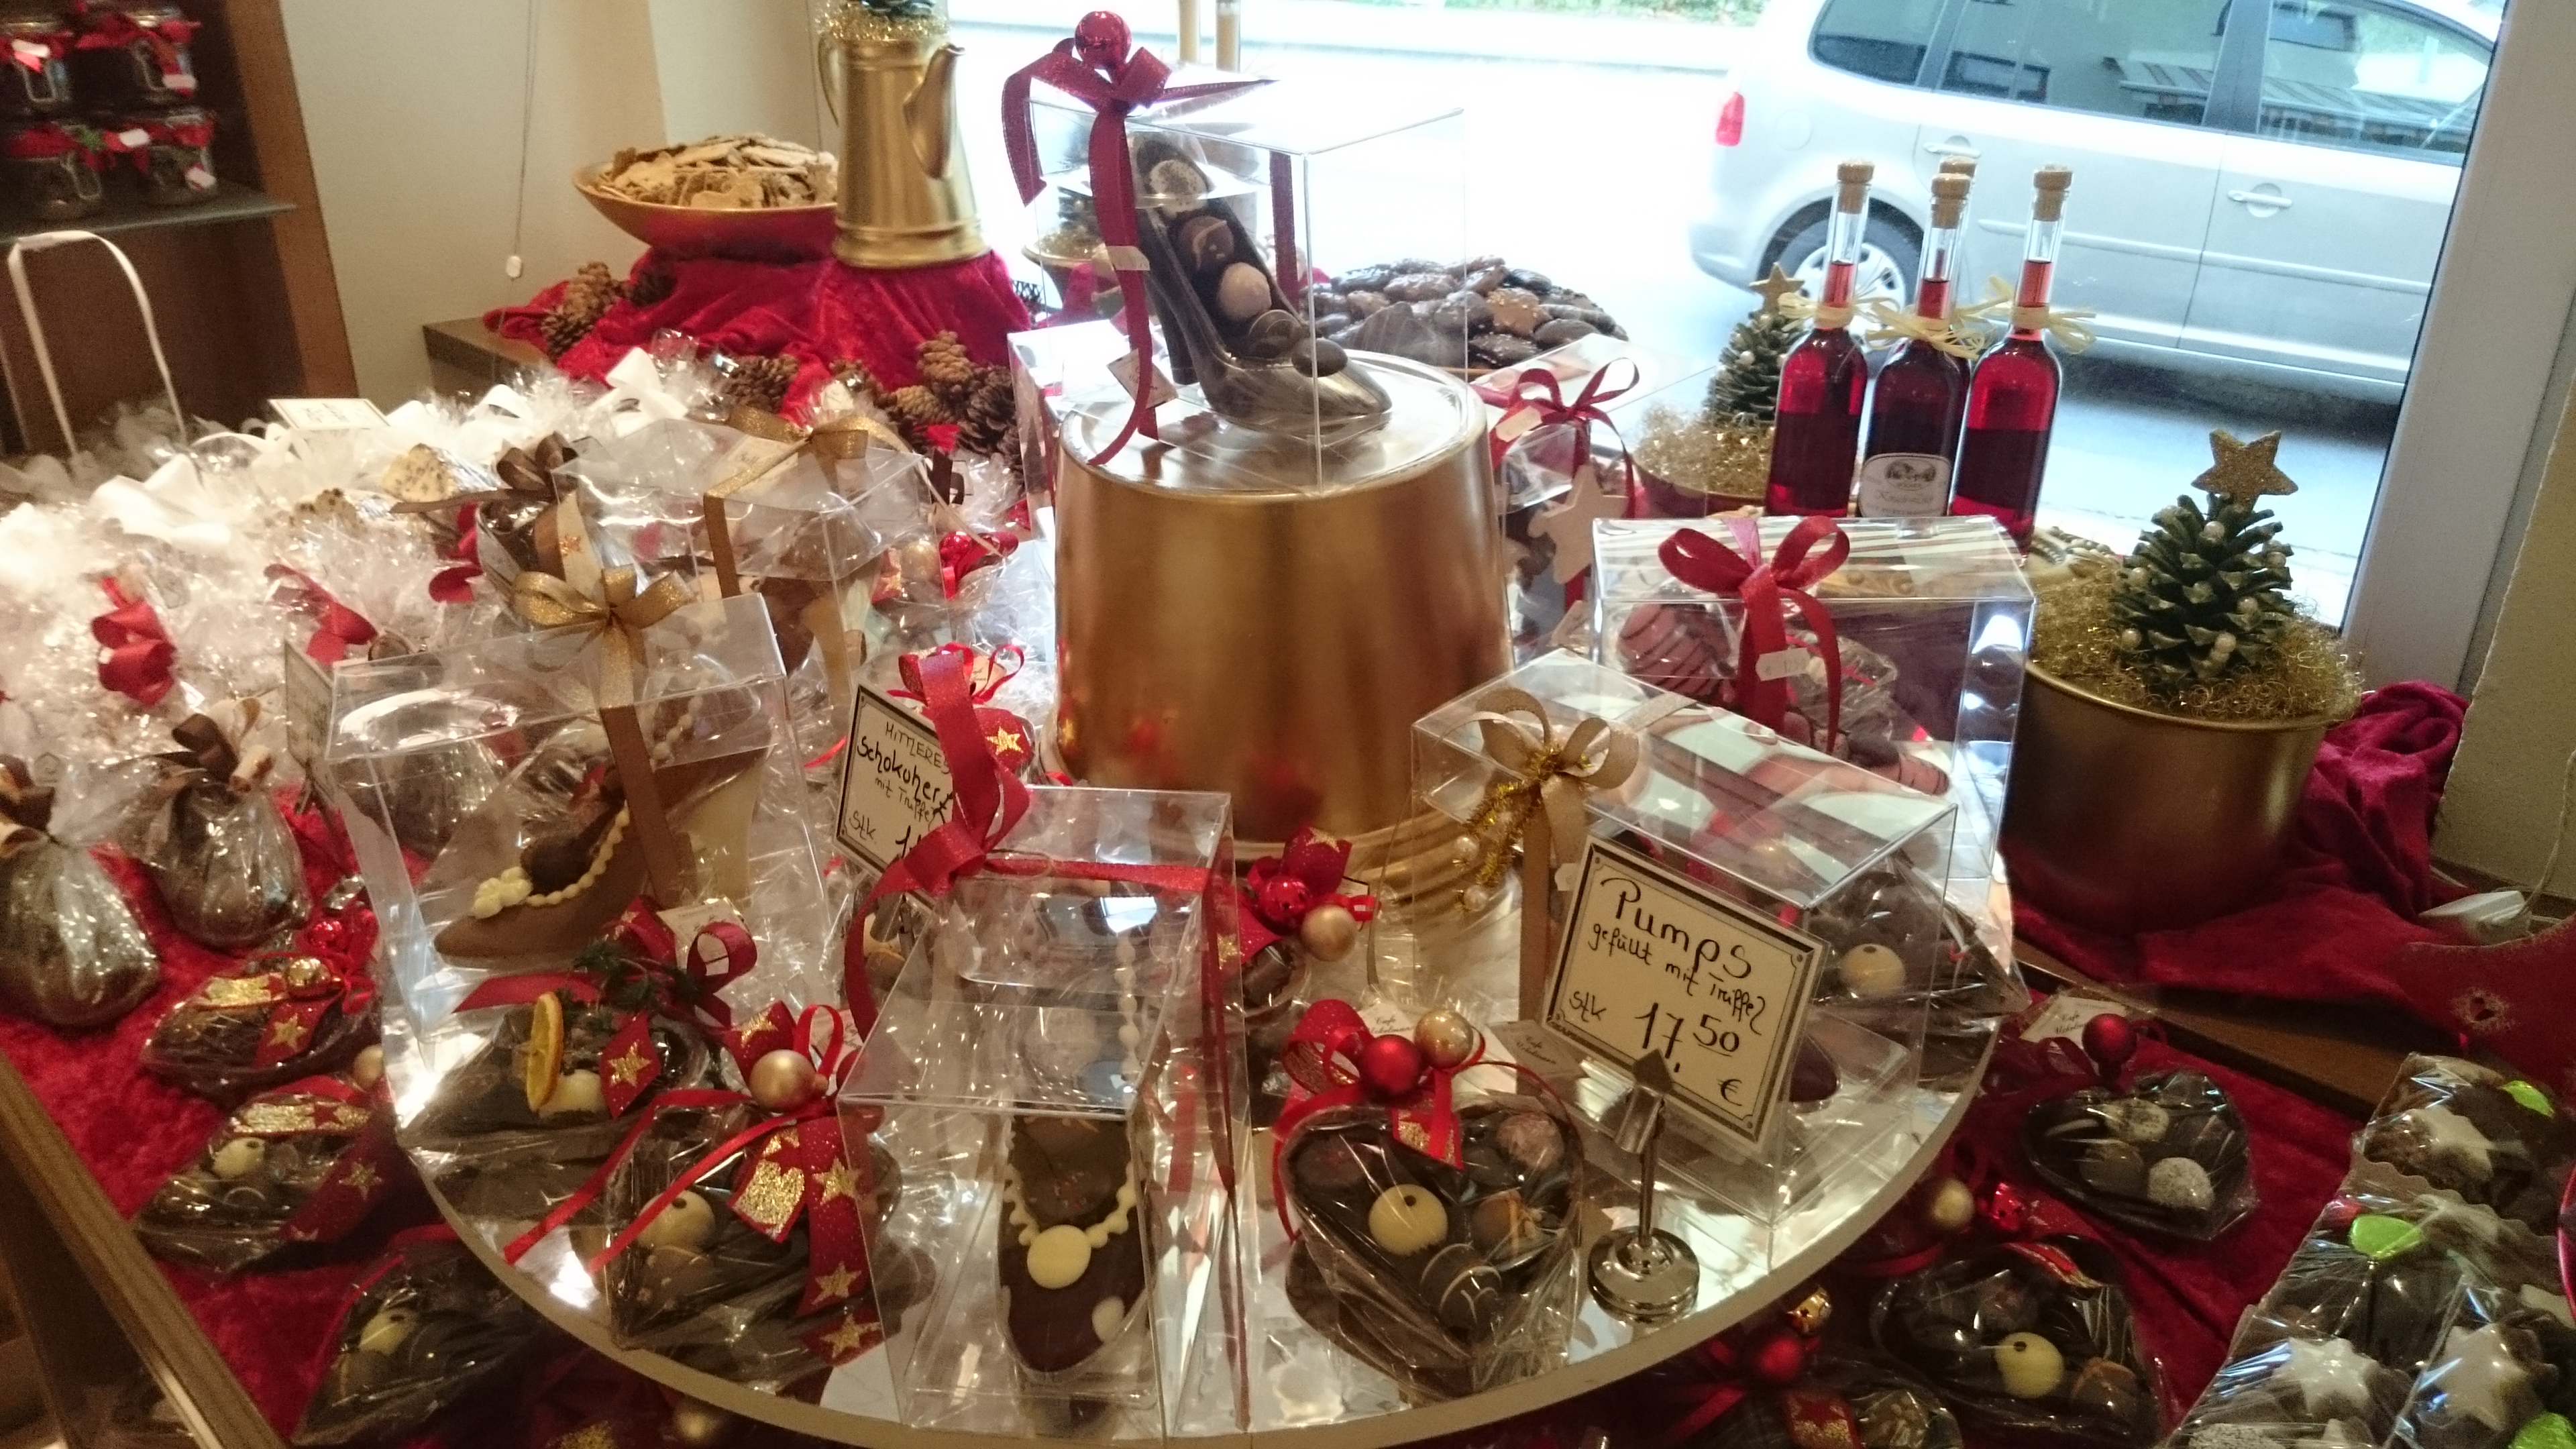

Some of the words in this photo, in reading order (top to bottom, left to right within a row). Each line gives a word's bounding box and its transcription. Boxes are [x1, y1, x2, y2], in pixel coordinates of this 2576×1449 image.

[875, 777, 894, 798] mit
[1665, 963, 1699, 997] mit
[1716, 1079, 1743, 1107] €
